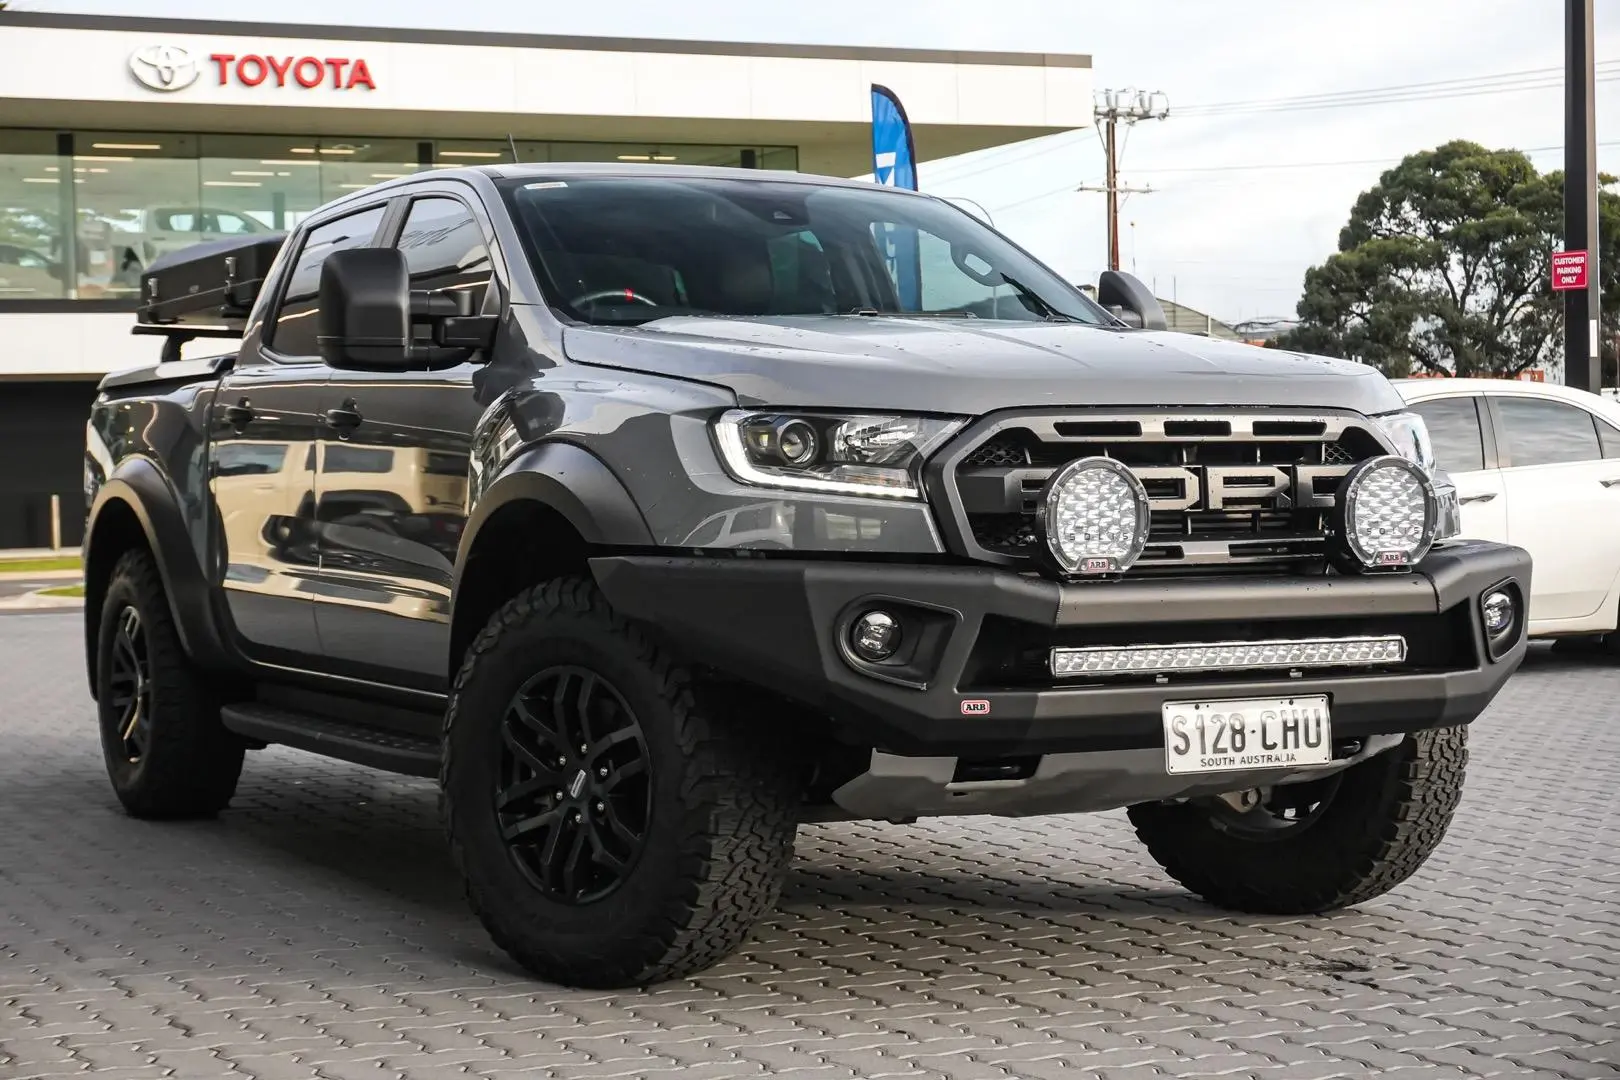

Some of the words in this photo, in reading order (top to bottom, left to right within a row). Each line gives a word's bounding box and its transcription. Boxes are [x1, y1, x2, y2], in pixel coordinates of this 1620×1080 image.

[210, 54, 376, 90] TOYOTA
[1554, 256, 1585, 265] CUSTOMER
[1556, 266, 1582, 275] PARKING
[1561, 275, 1577, 284] ONLY
[1089, 561, 1106, 569] ARB
[965, 703, 986, 711] ARB
[1200, 755, 1235, 767] SOUTH
[1240, 752, 1297, 765] AUSTRALIA
